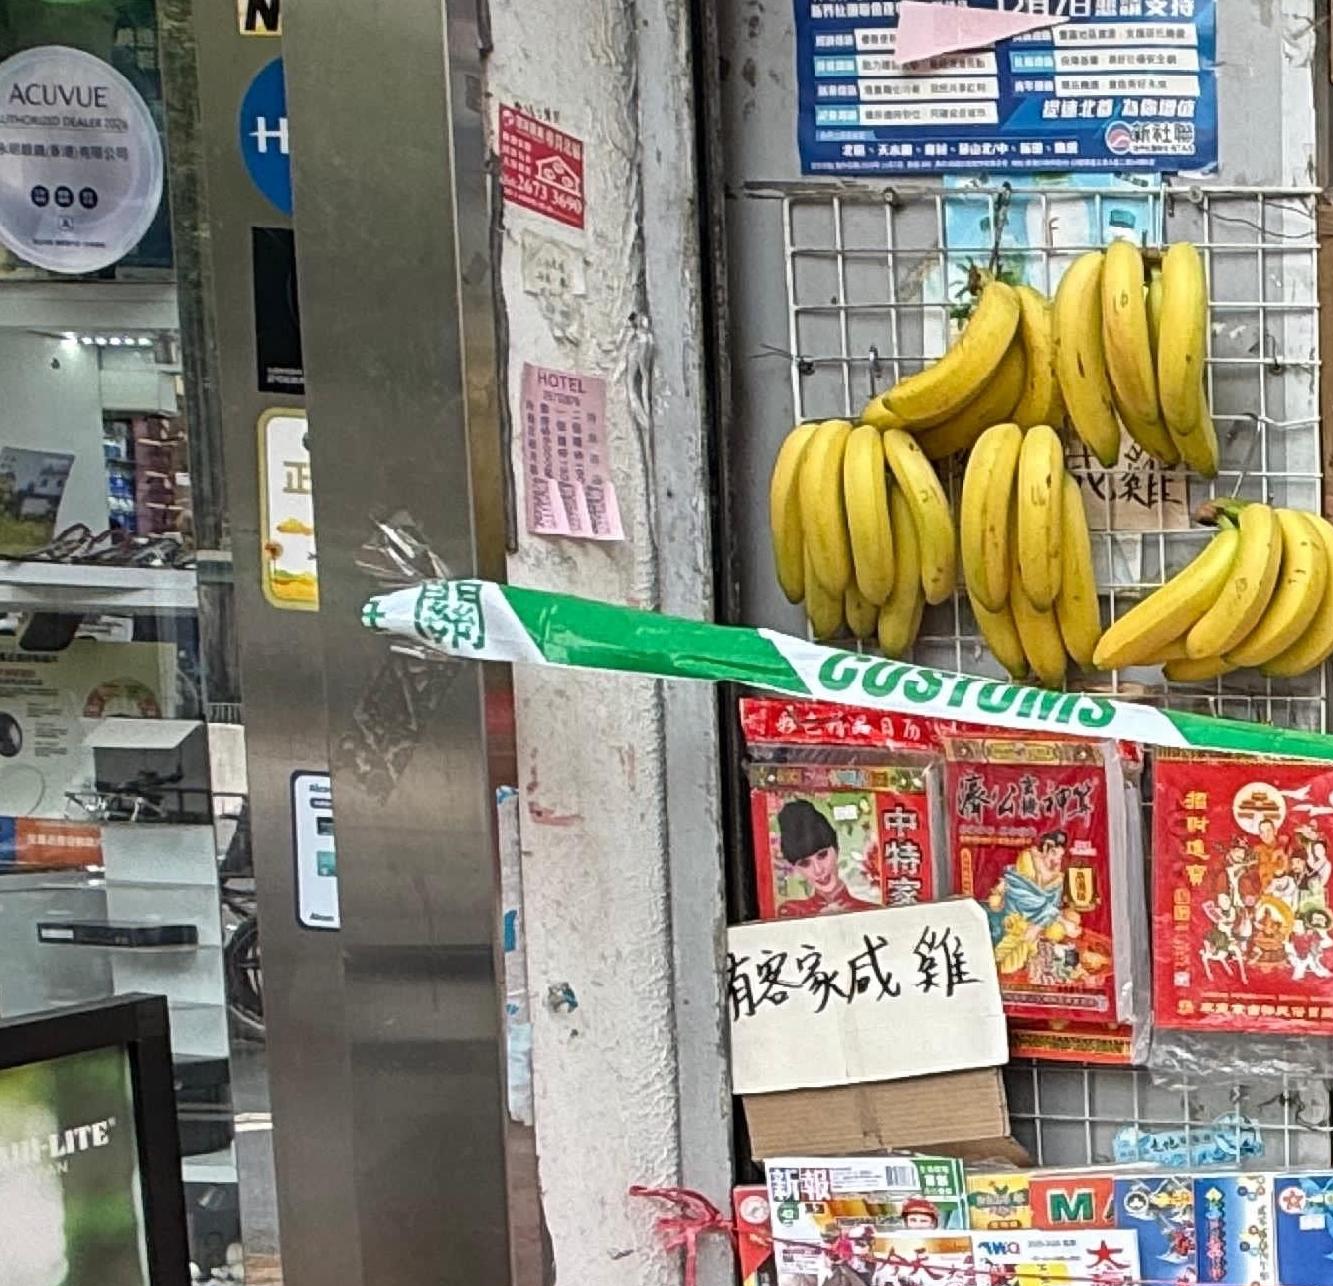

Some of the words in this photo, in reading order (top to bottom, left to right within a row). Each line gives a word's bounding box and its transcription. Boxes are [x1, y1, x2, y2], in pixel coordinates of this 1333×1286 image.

[9, 82, 110, 109] ACUVUE
[537, 368, 587, 395] HOTEL
[817, 650, 1118, 728] CUSTOMS
[727, 925, 984, 1021] 有客家咸雞
